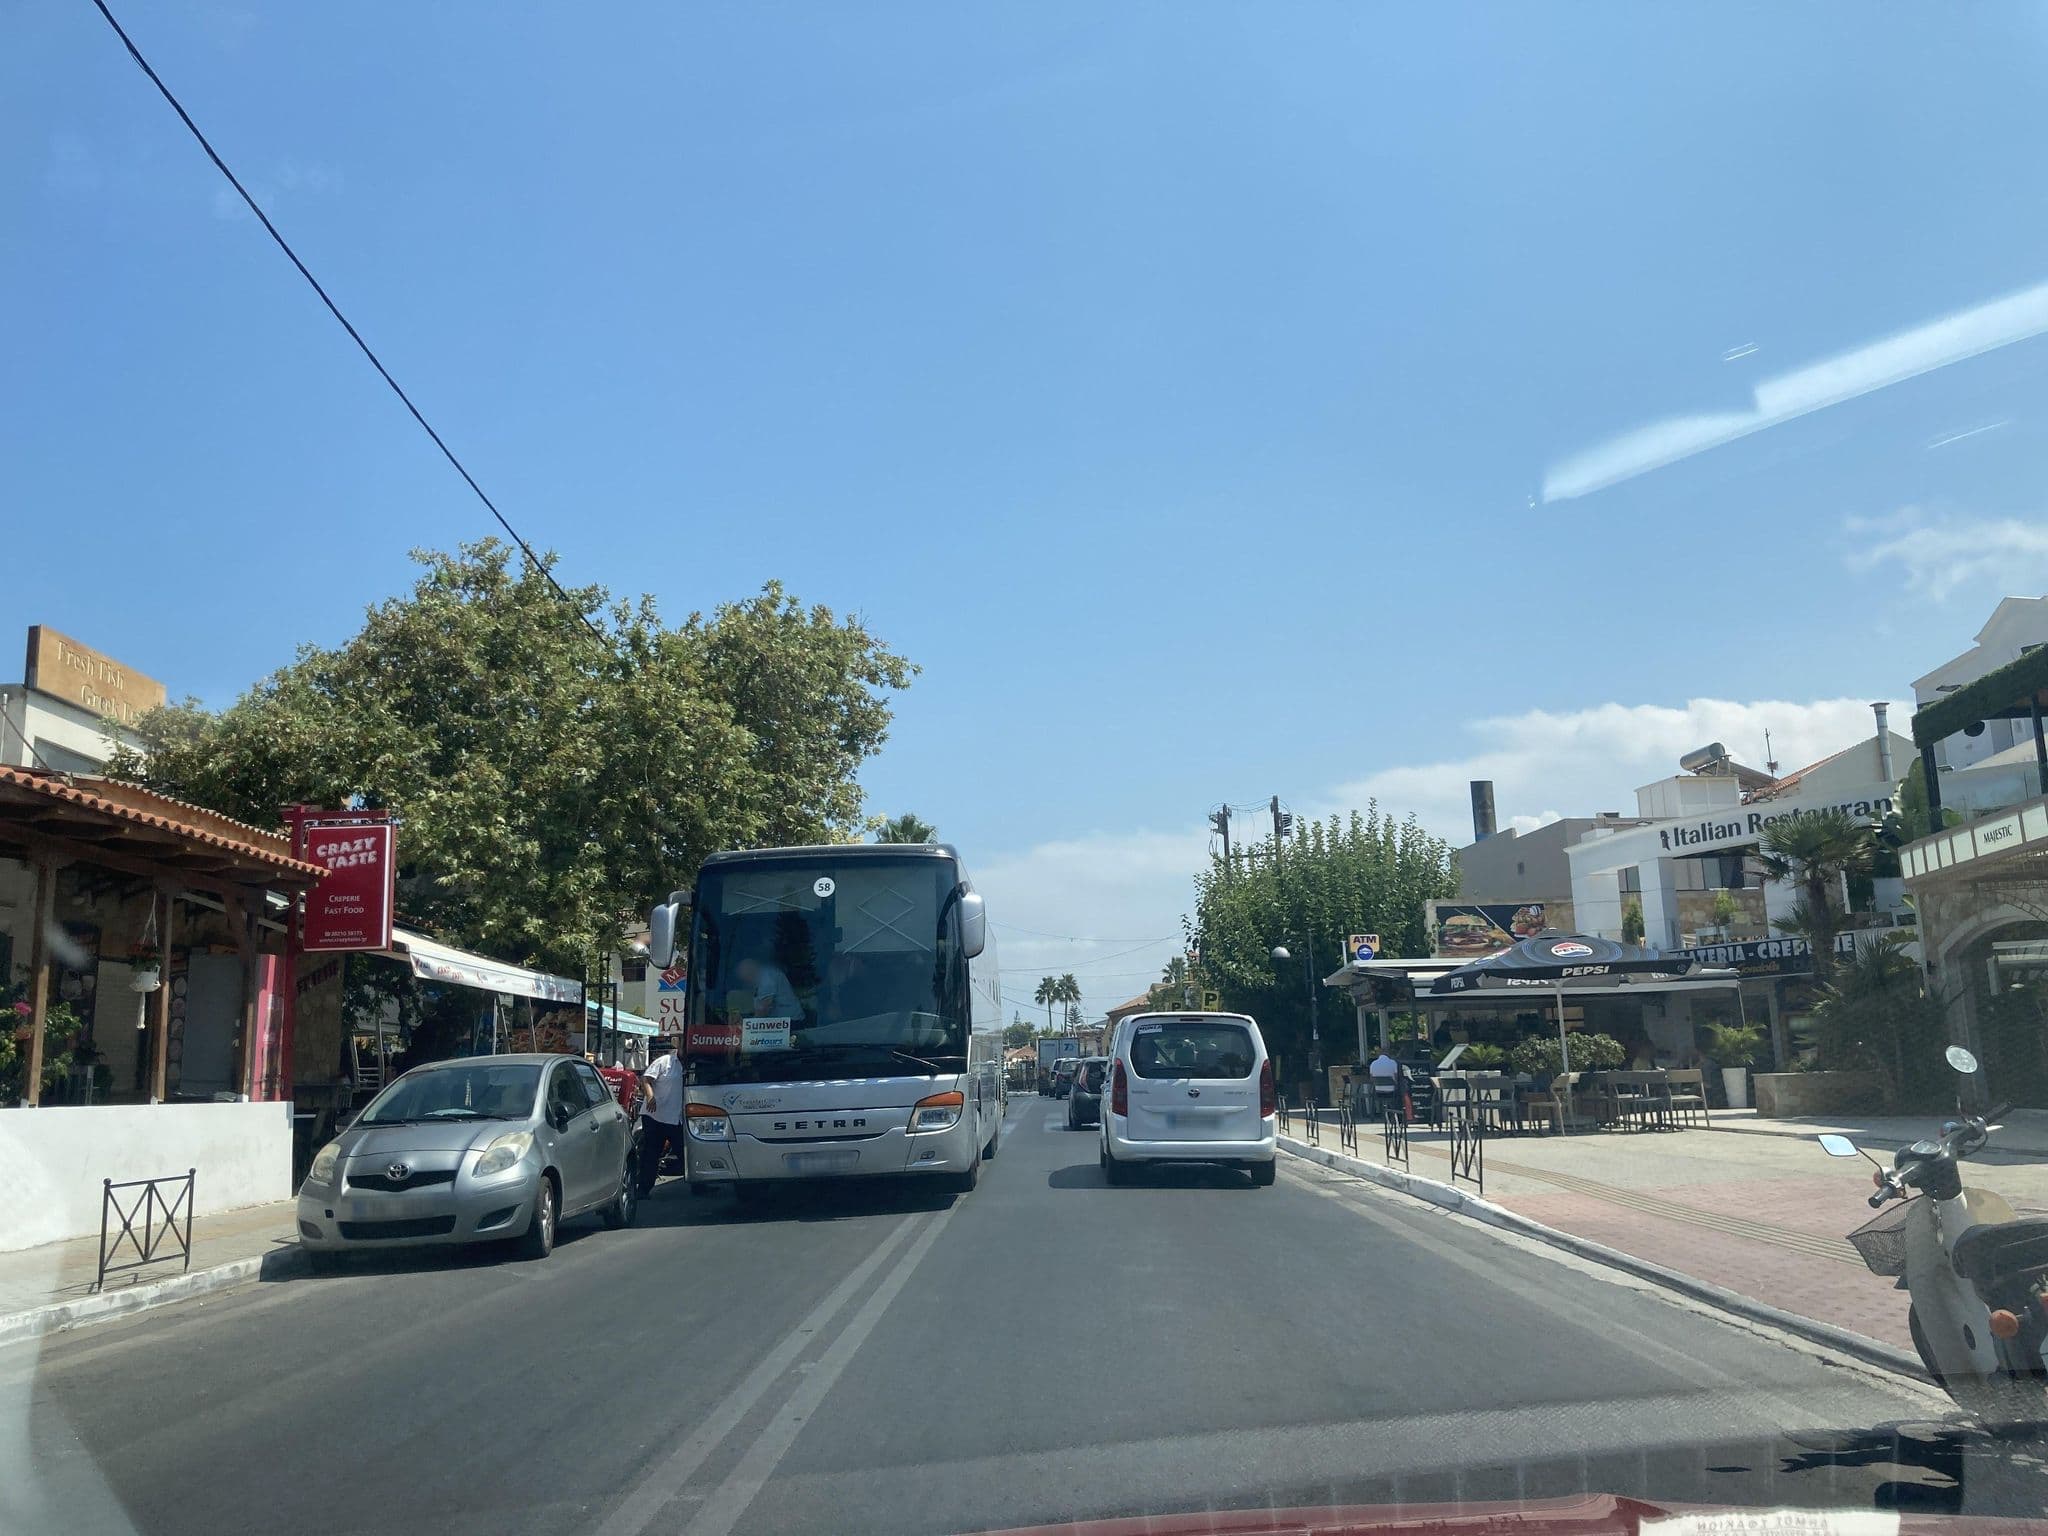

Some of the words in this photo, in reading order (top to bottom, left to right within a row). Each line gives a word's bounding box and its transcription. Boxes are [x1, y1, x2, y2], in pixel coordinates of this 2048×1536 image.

[57, 640, 95, 677] Fresh
[98, 660, 125, 690] Fish
[81, 684, 119, 718] Greek
[1673, 822, 1742, 847] Italian
[1983, 825, 2013, 843] MAJESTIC
[316, 837, 377, 858] CRAZY
[326, 851, 377, 869] TASTE
[818, 883, 831, 891] 58
[324, 906, 342, 915] FAST
[343, 906, 364, 914] FOOD
[1353, 935, 1377, 943] ATM
[666, 970, 680, 983] M
[1561, 965, 1610, 977] PEPSI
[1450, 977, 1466, 990] PEPSI
[1204, 992, 1218, 1006] P
[660, 998, 685, 1014] SU
[1171, 1002, 1181, 1011] P
[745, 1020, 789, 1031] Sunweb
[692, 1033, 741, 1047] Sunweb
[774, 1118, 866, 1131] SETRA
